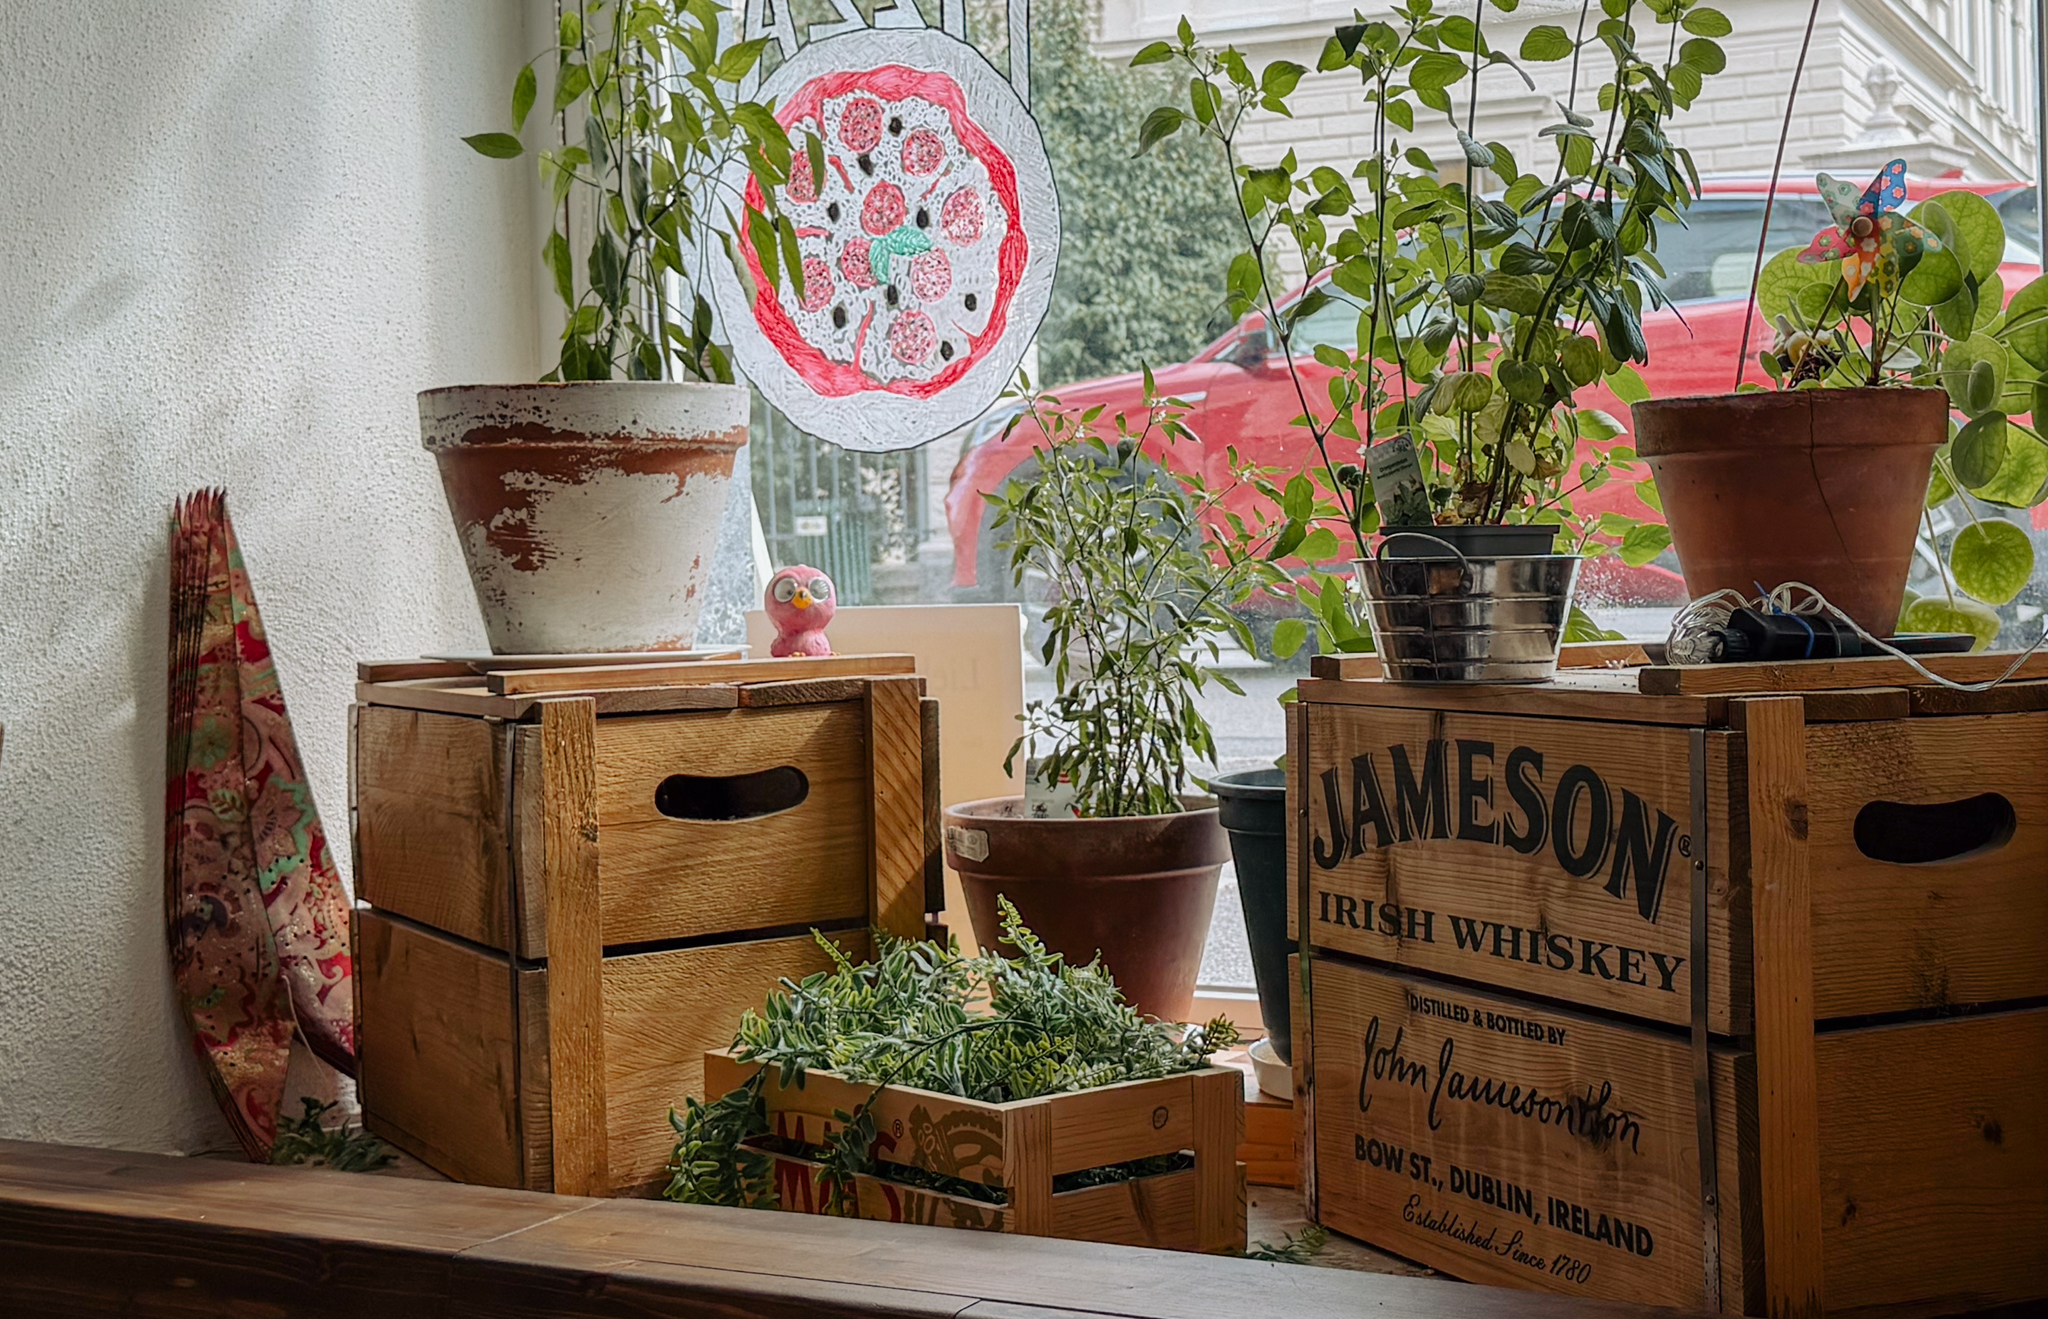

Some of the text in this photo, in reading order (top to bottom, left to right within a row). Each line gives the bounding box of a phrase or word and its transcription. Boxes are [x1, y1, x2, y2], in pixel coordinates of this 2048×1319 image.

[1318, 890, 1687, 993] IRISH WHISKEY
[1410, 993, 1567, 1047] DISTILLED & BOTTLED BY
[1358, 1015, 1428, 1113] John
[1428, 1037, 1575, 1136] Jameson
[1355, 1133, 1654, 1258] BOW ST., DUBLIN, IRELAND
[1402, 1193, 1592, 1284] Established Since 1780
